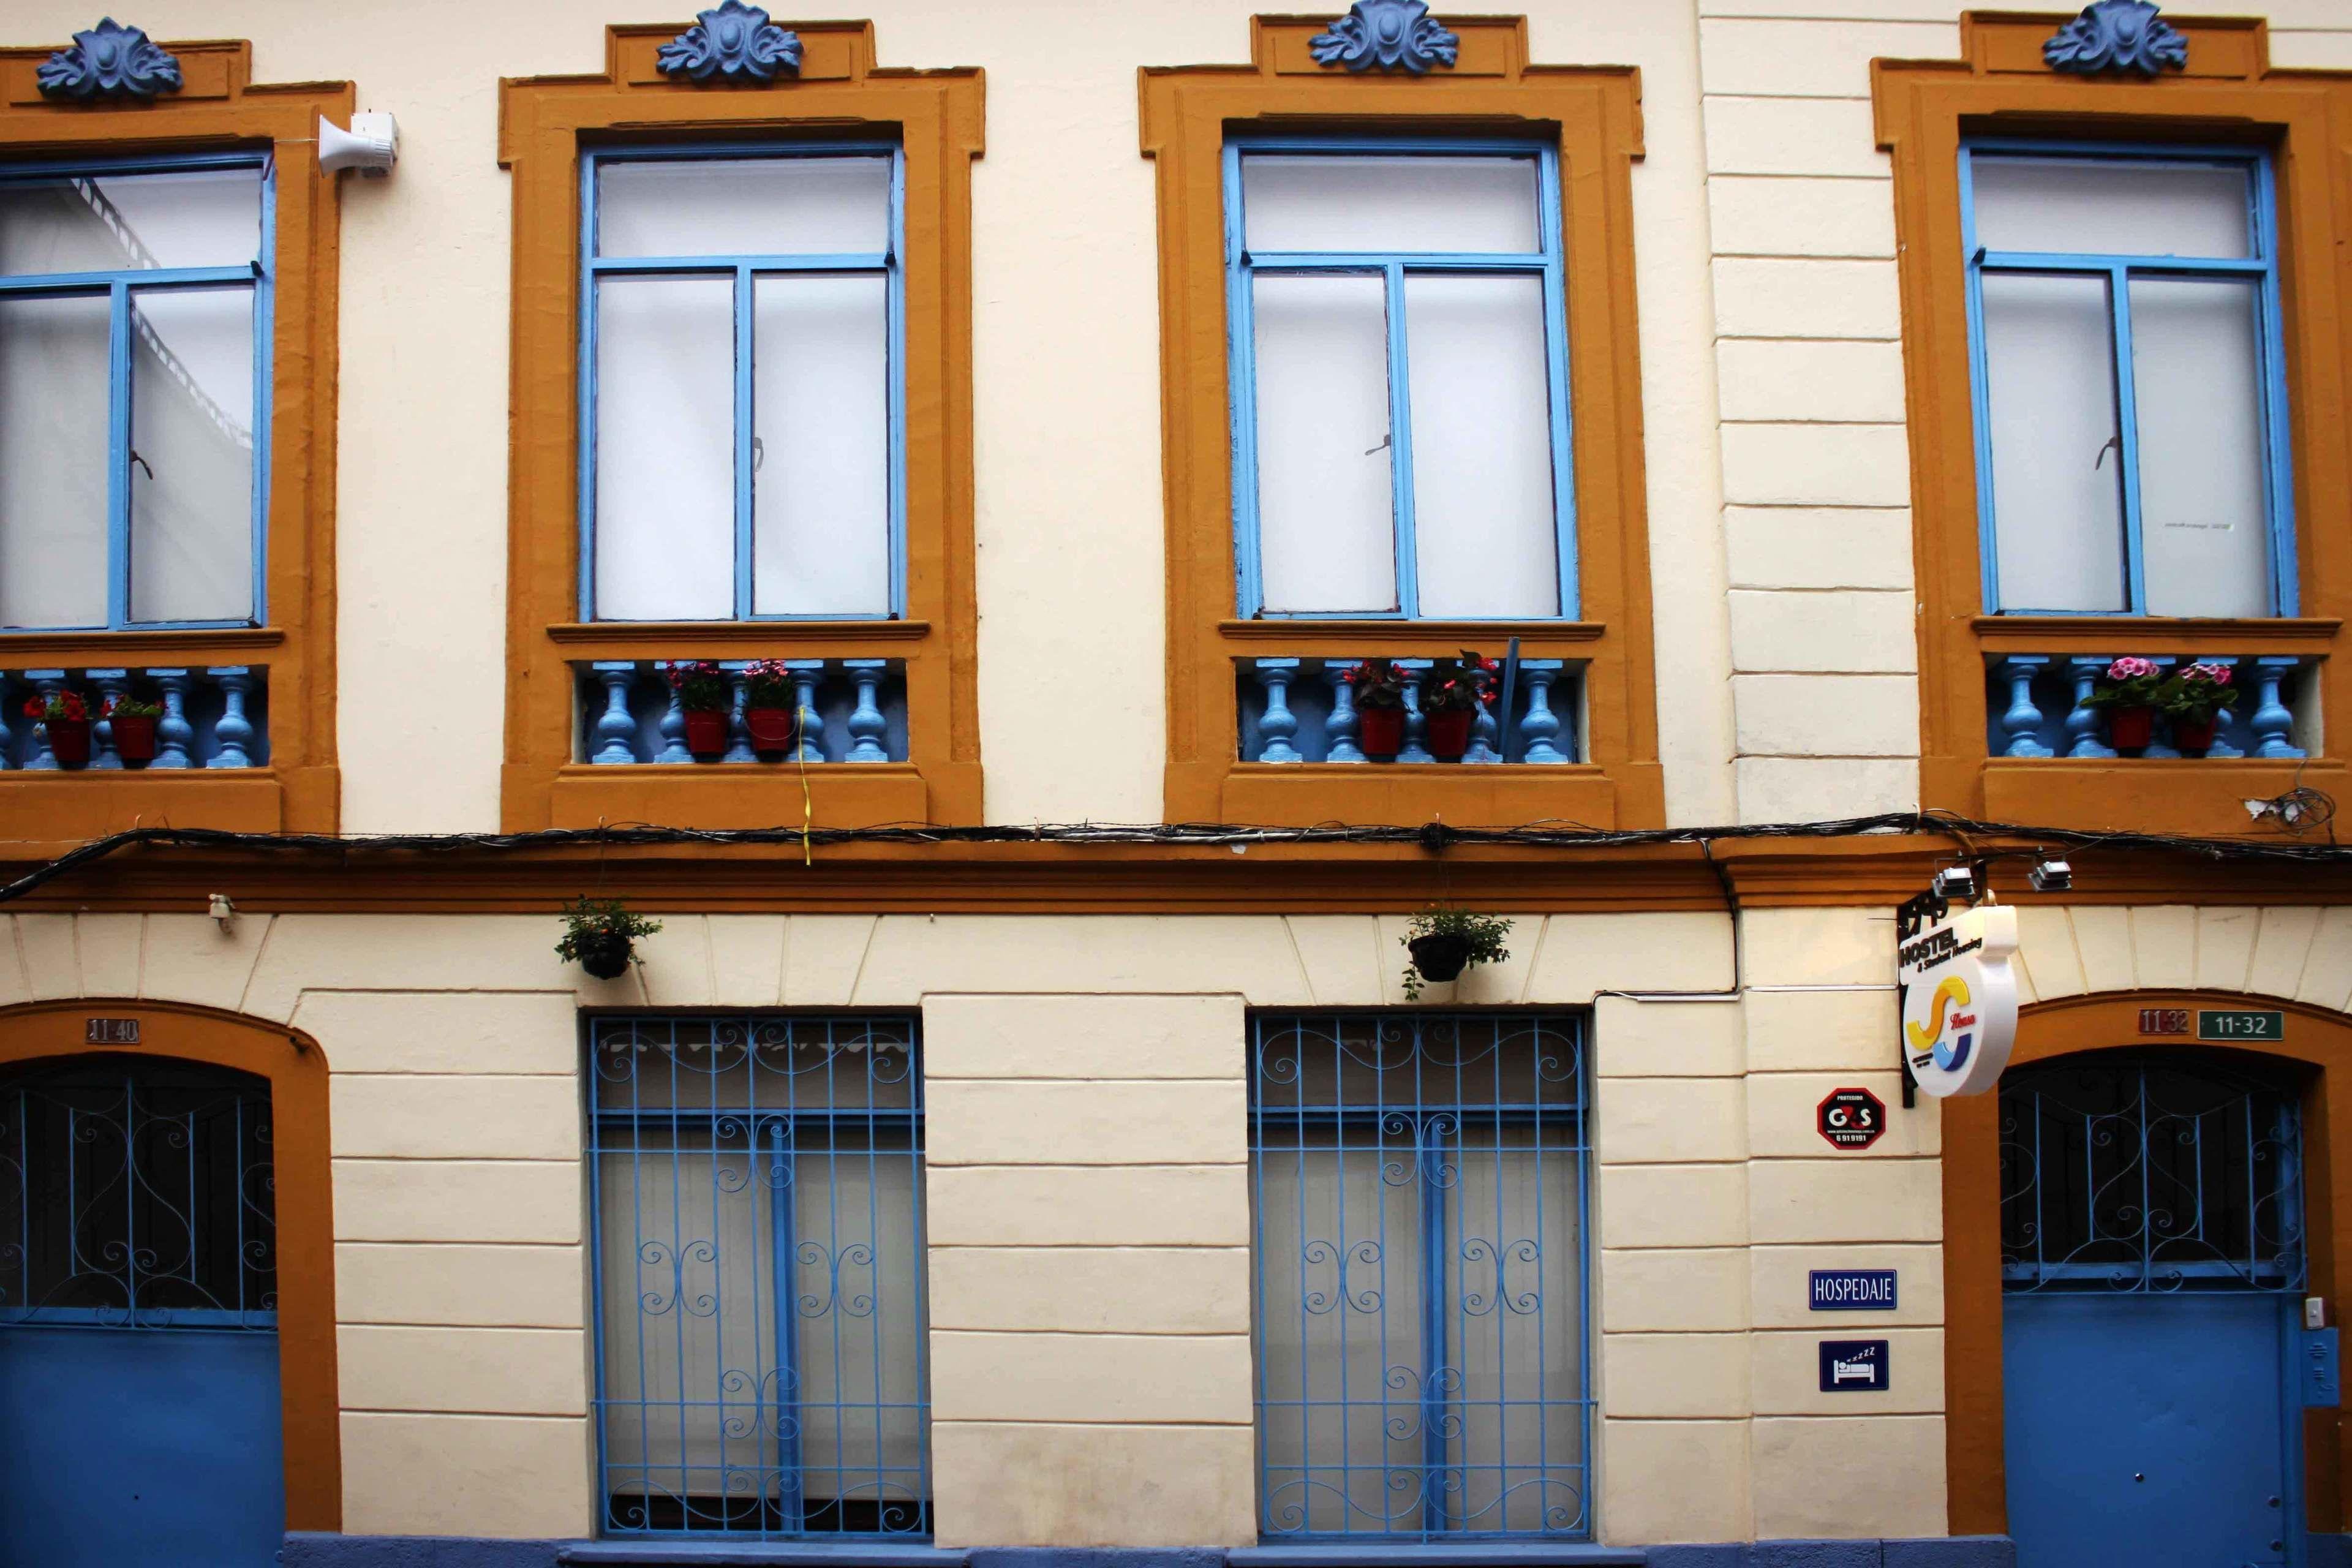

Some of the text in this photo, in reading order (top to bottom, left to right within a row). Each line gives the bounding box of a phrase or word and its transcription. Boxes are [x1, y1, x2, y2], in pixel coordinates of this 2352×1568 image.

[1899, 927, 1958, 968] HOSTEL
[2215, 1017, 2266, 1033] 11-32
[1815, 1278, 1891, 1300] HOSPEDAJE
